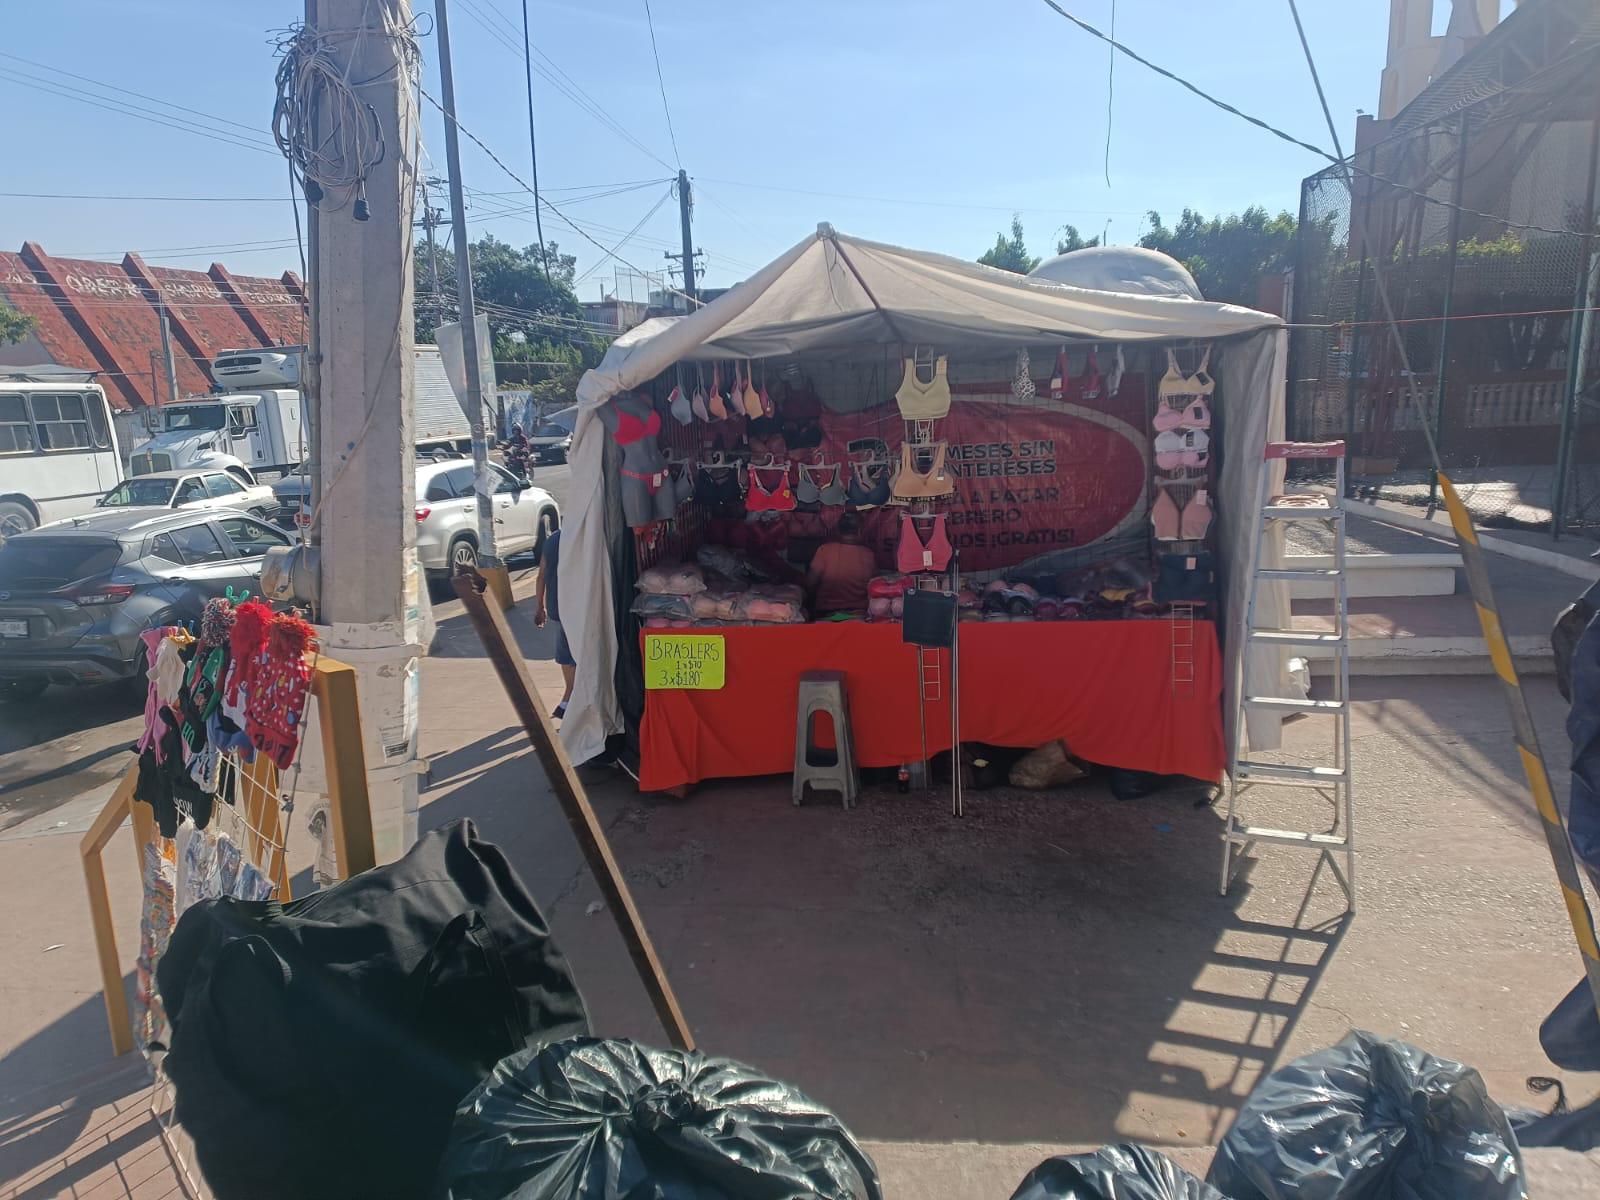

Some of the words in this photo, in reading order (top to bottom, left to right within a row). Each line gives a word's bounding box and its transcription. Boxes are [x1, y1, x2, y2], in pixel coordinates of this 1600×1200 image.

[946, 442, 1014, 460] MESES
[1018, 440, 1056, 458] SIN
[948, 508, 1021, 526] BRERO
